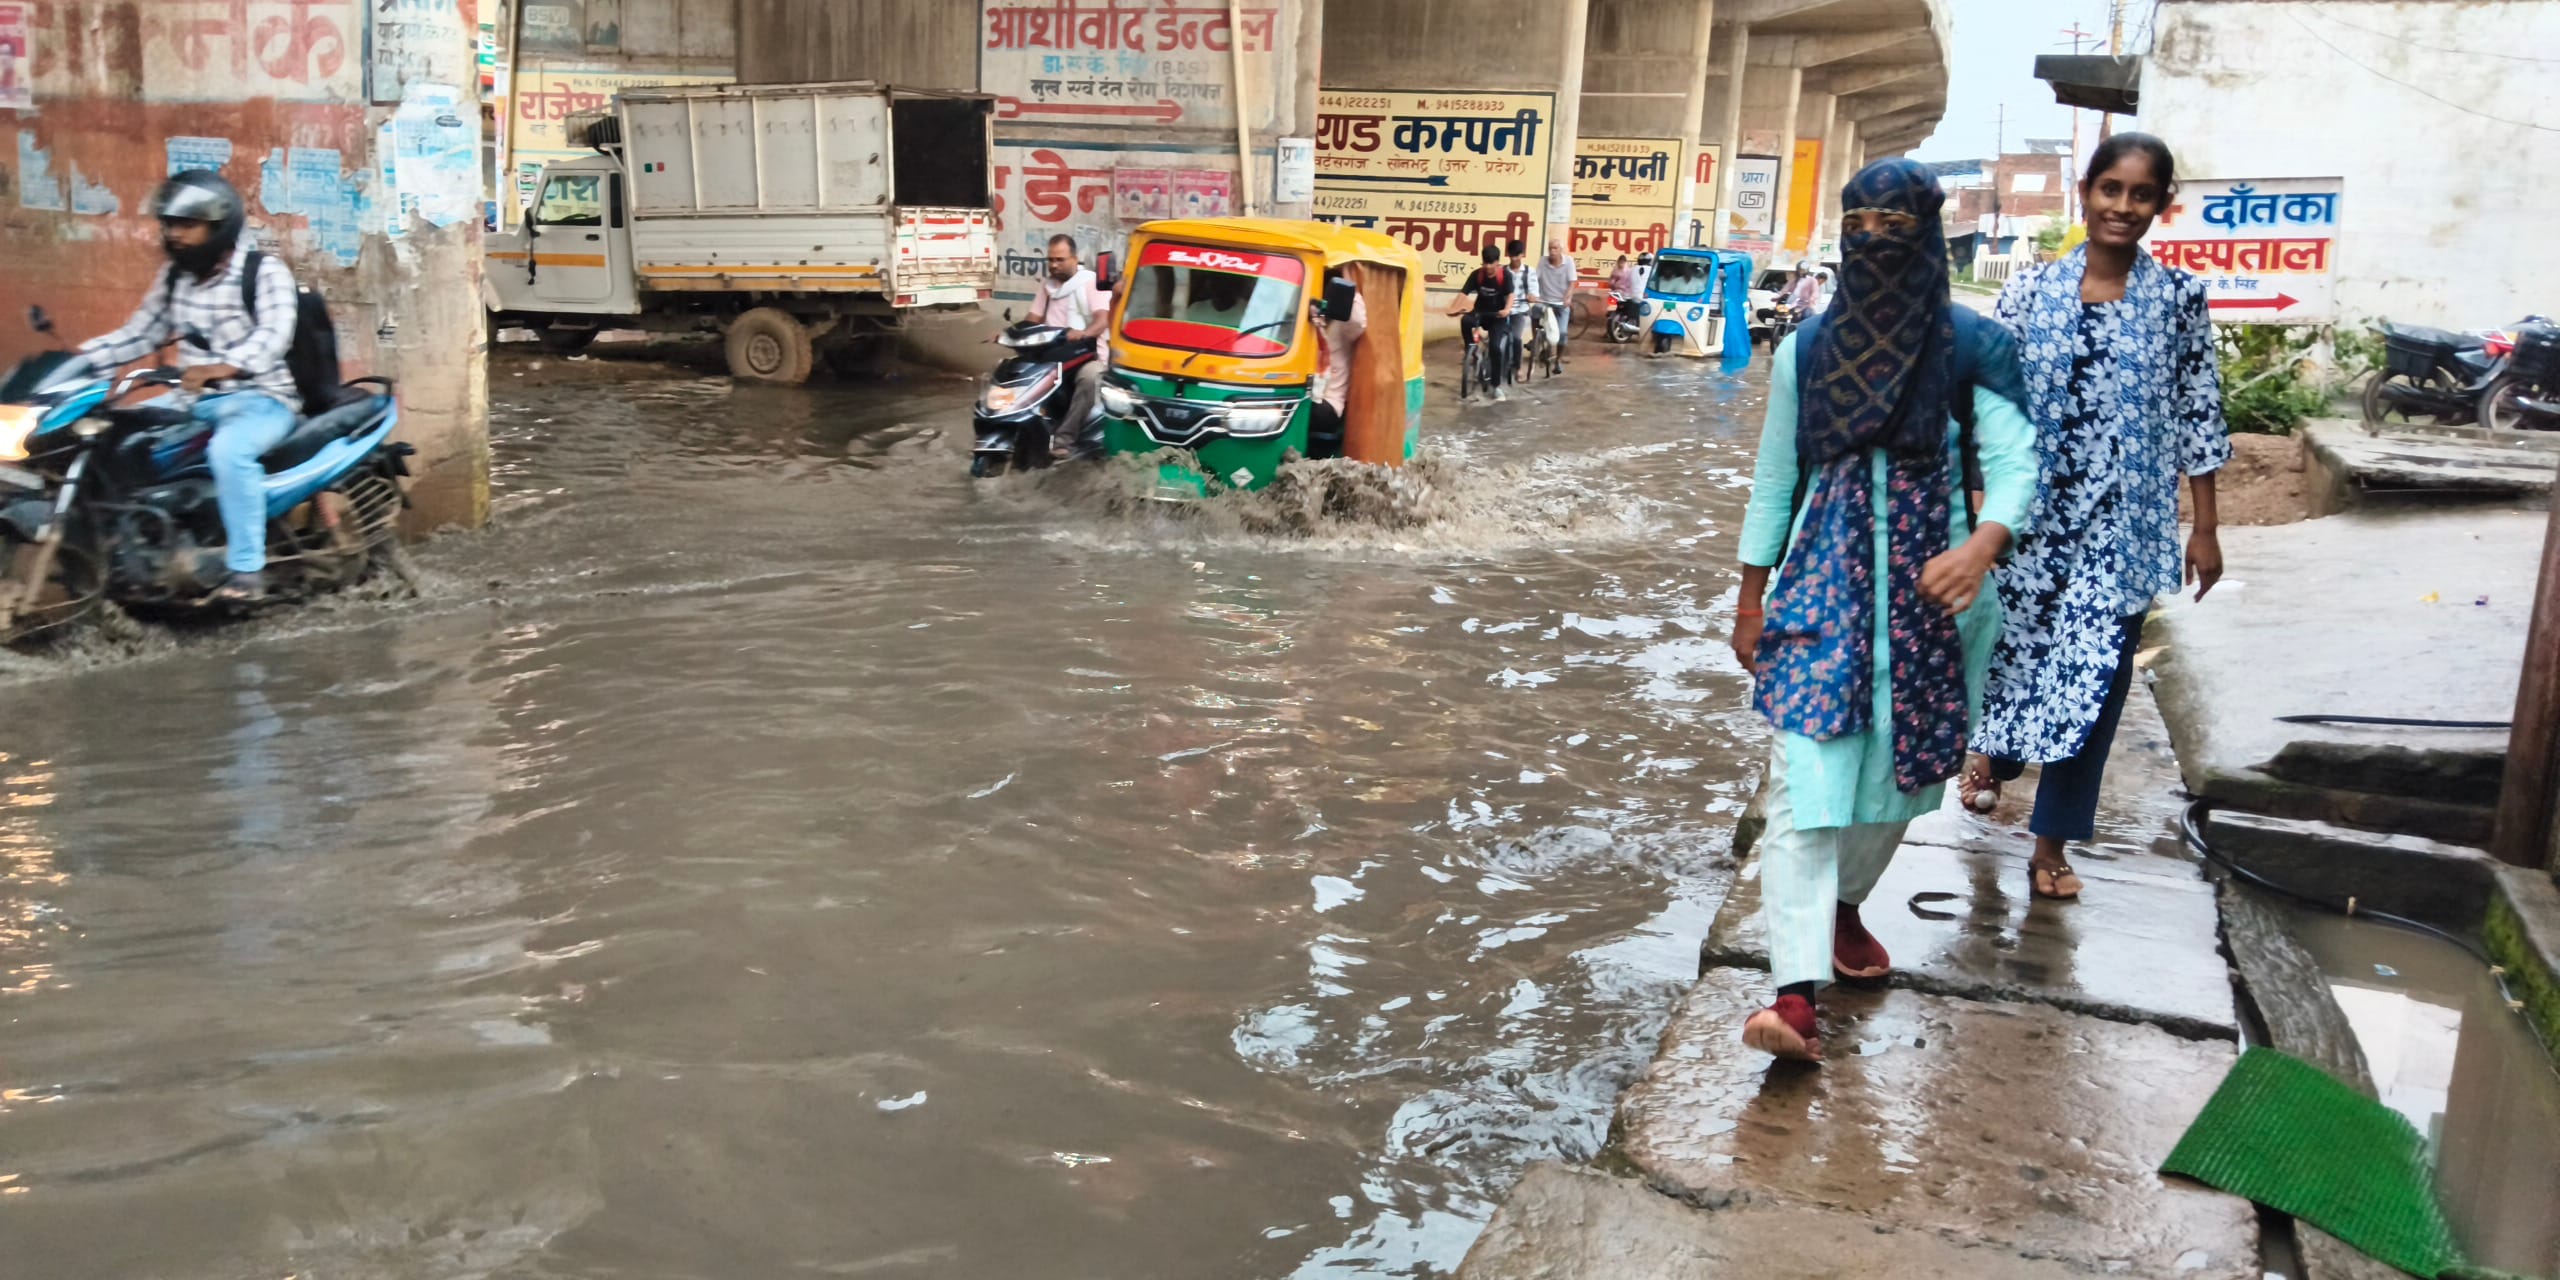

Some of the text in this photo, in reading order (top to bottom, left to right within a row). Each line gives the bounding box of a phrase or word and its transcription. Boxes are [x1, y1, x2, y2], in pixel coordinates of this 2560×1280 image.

[1391, 108, 1544, 156] कम्पनी
[1573, 151, 1670, 182] कम्पनी
[2203, 182, 2338, 230] दाँत का
[1384, 211, 1535, 257] कम्पनी
[2150, 237, 2332, 271] अस्पताल
